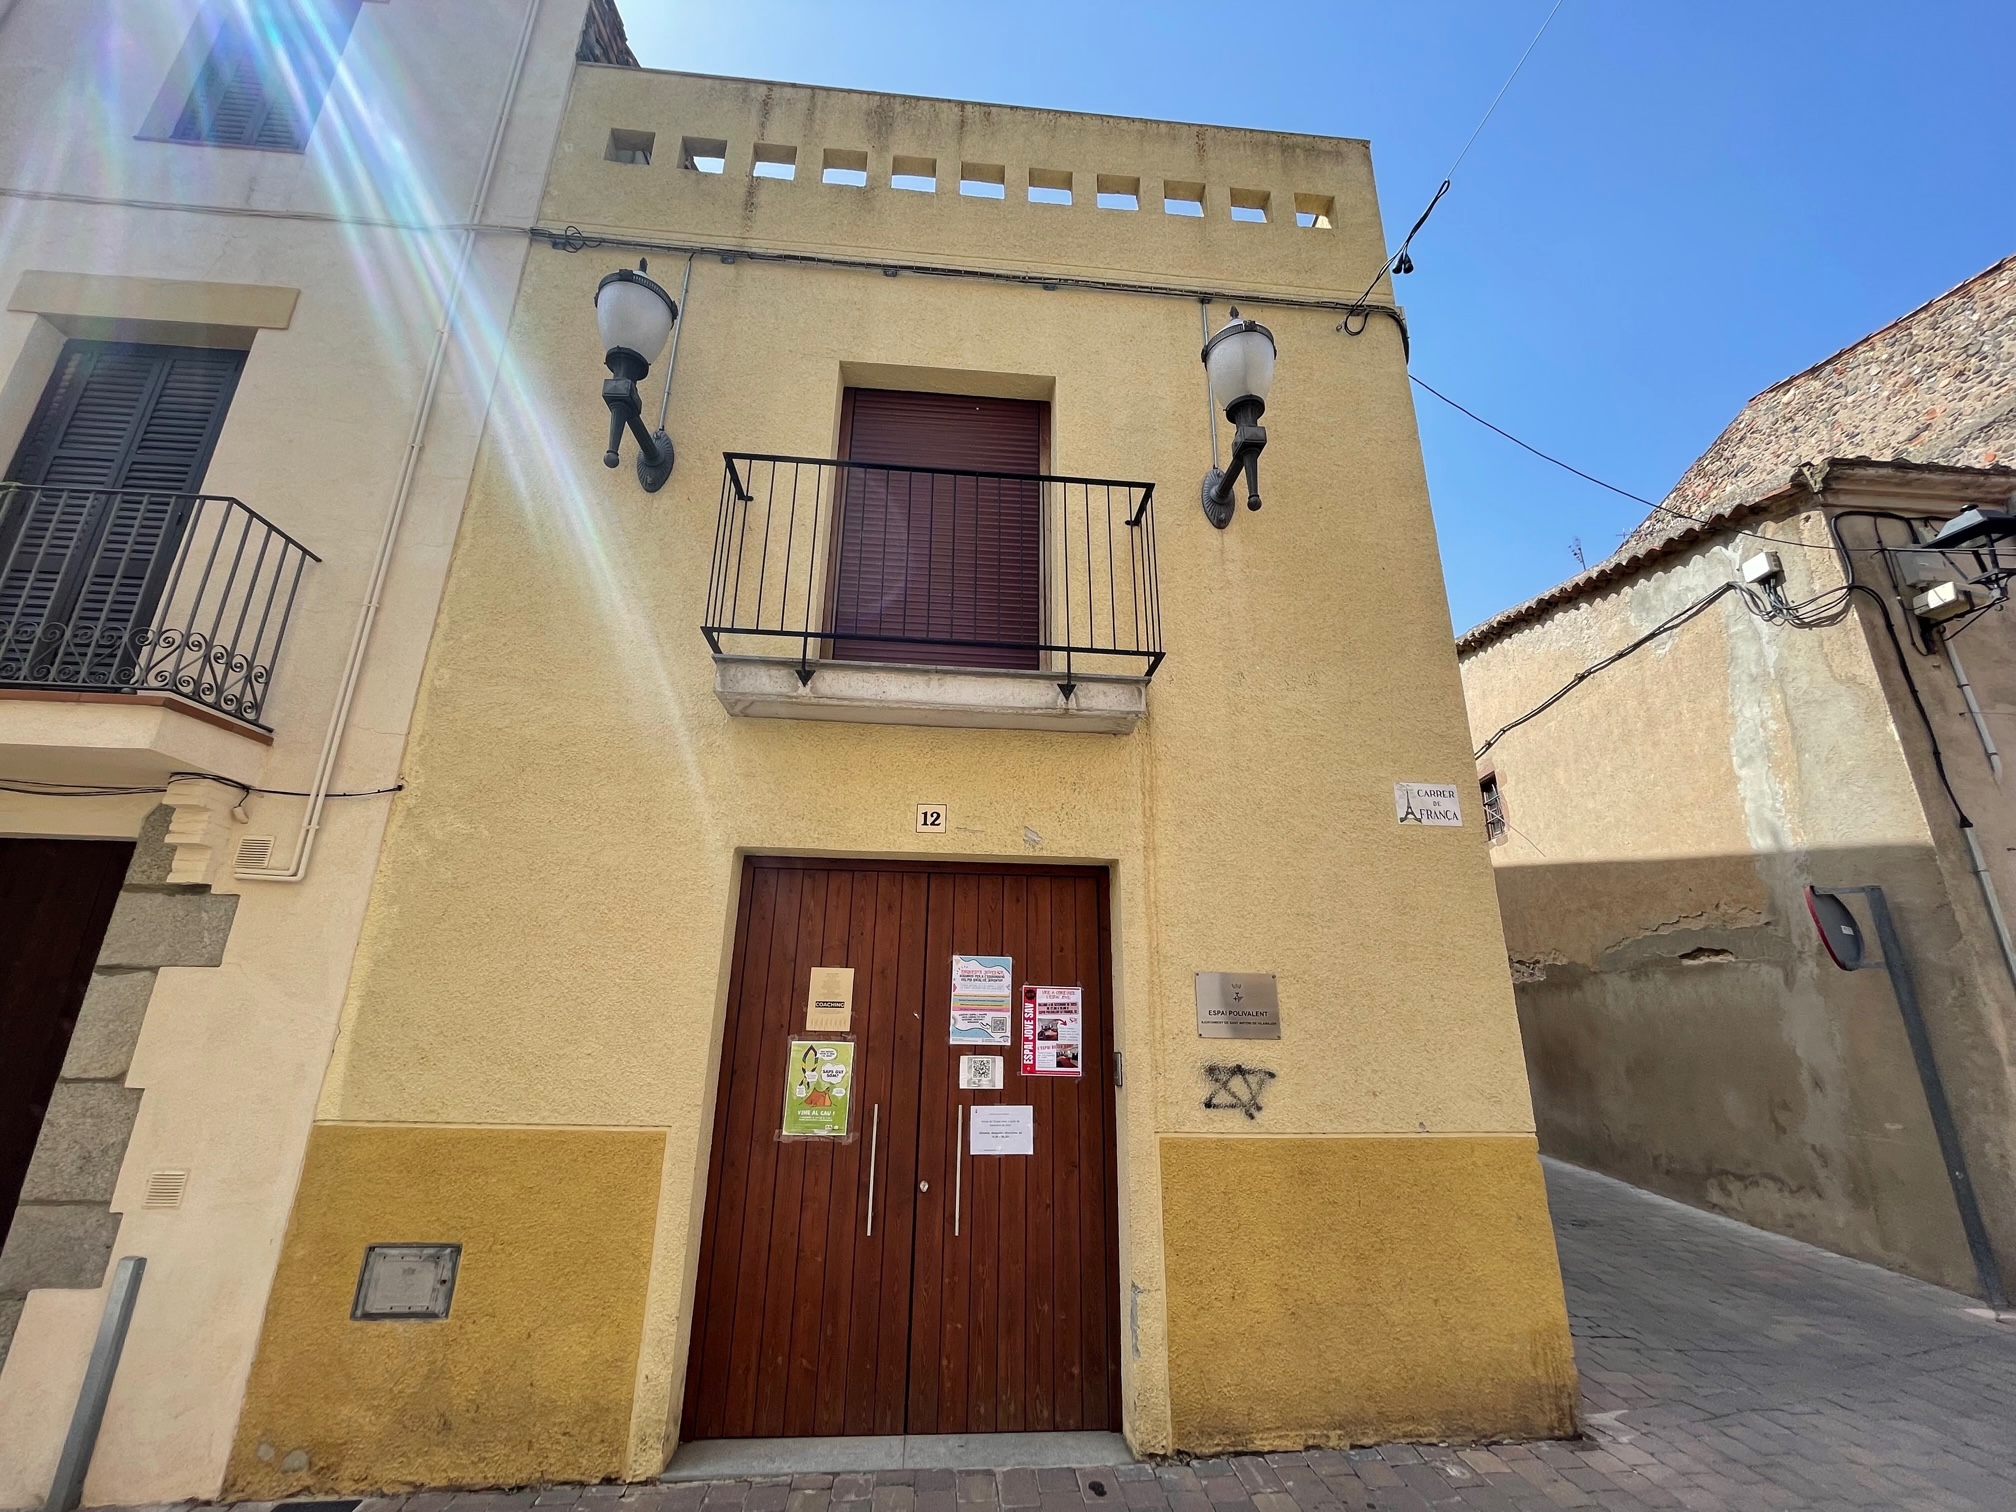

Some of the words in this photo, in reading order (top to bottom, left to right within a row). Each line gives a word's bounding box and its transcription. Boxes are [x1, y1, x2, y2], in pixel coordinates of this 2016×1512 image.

[1417, 789, 1455, 798] CARRER
[921, 811, 942, 826] 12
[1420, 808, 1459, 821] FRANÇA
[1024, 1003, 1034, 1019] SAV
[1024, 1020, 1034, 1040] JOVE
[1024, 1042, 1034, 1064] ESPAI
